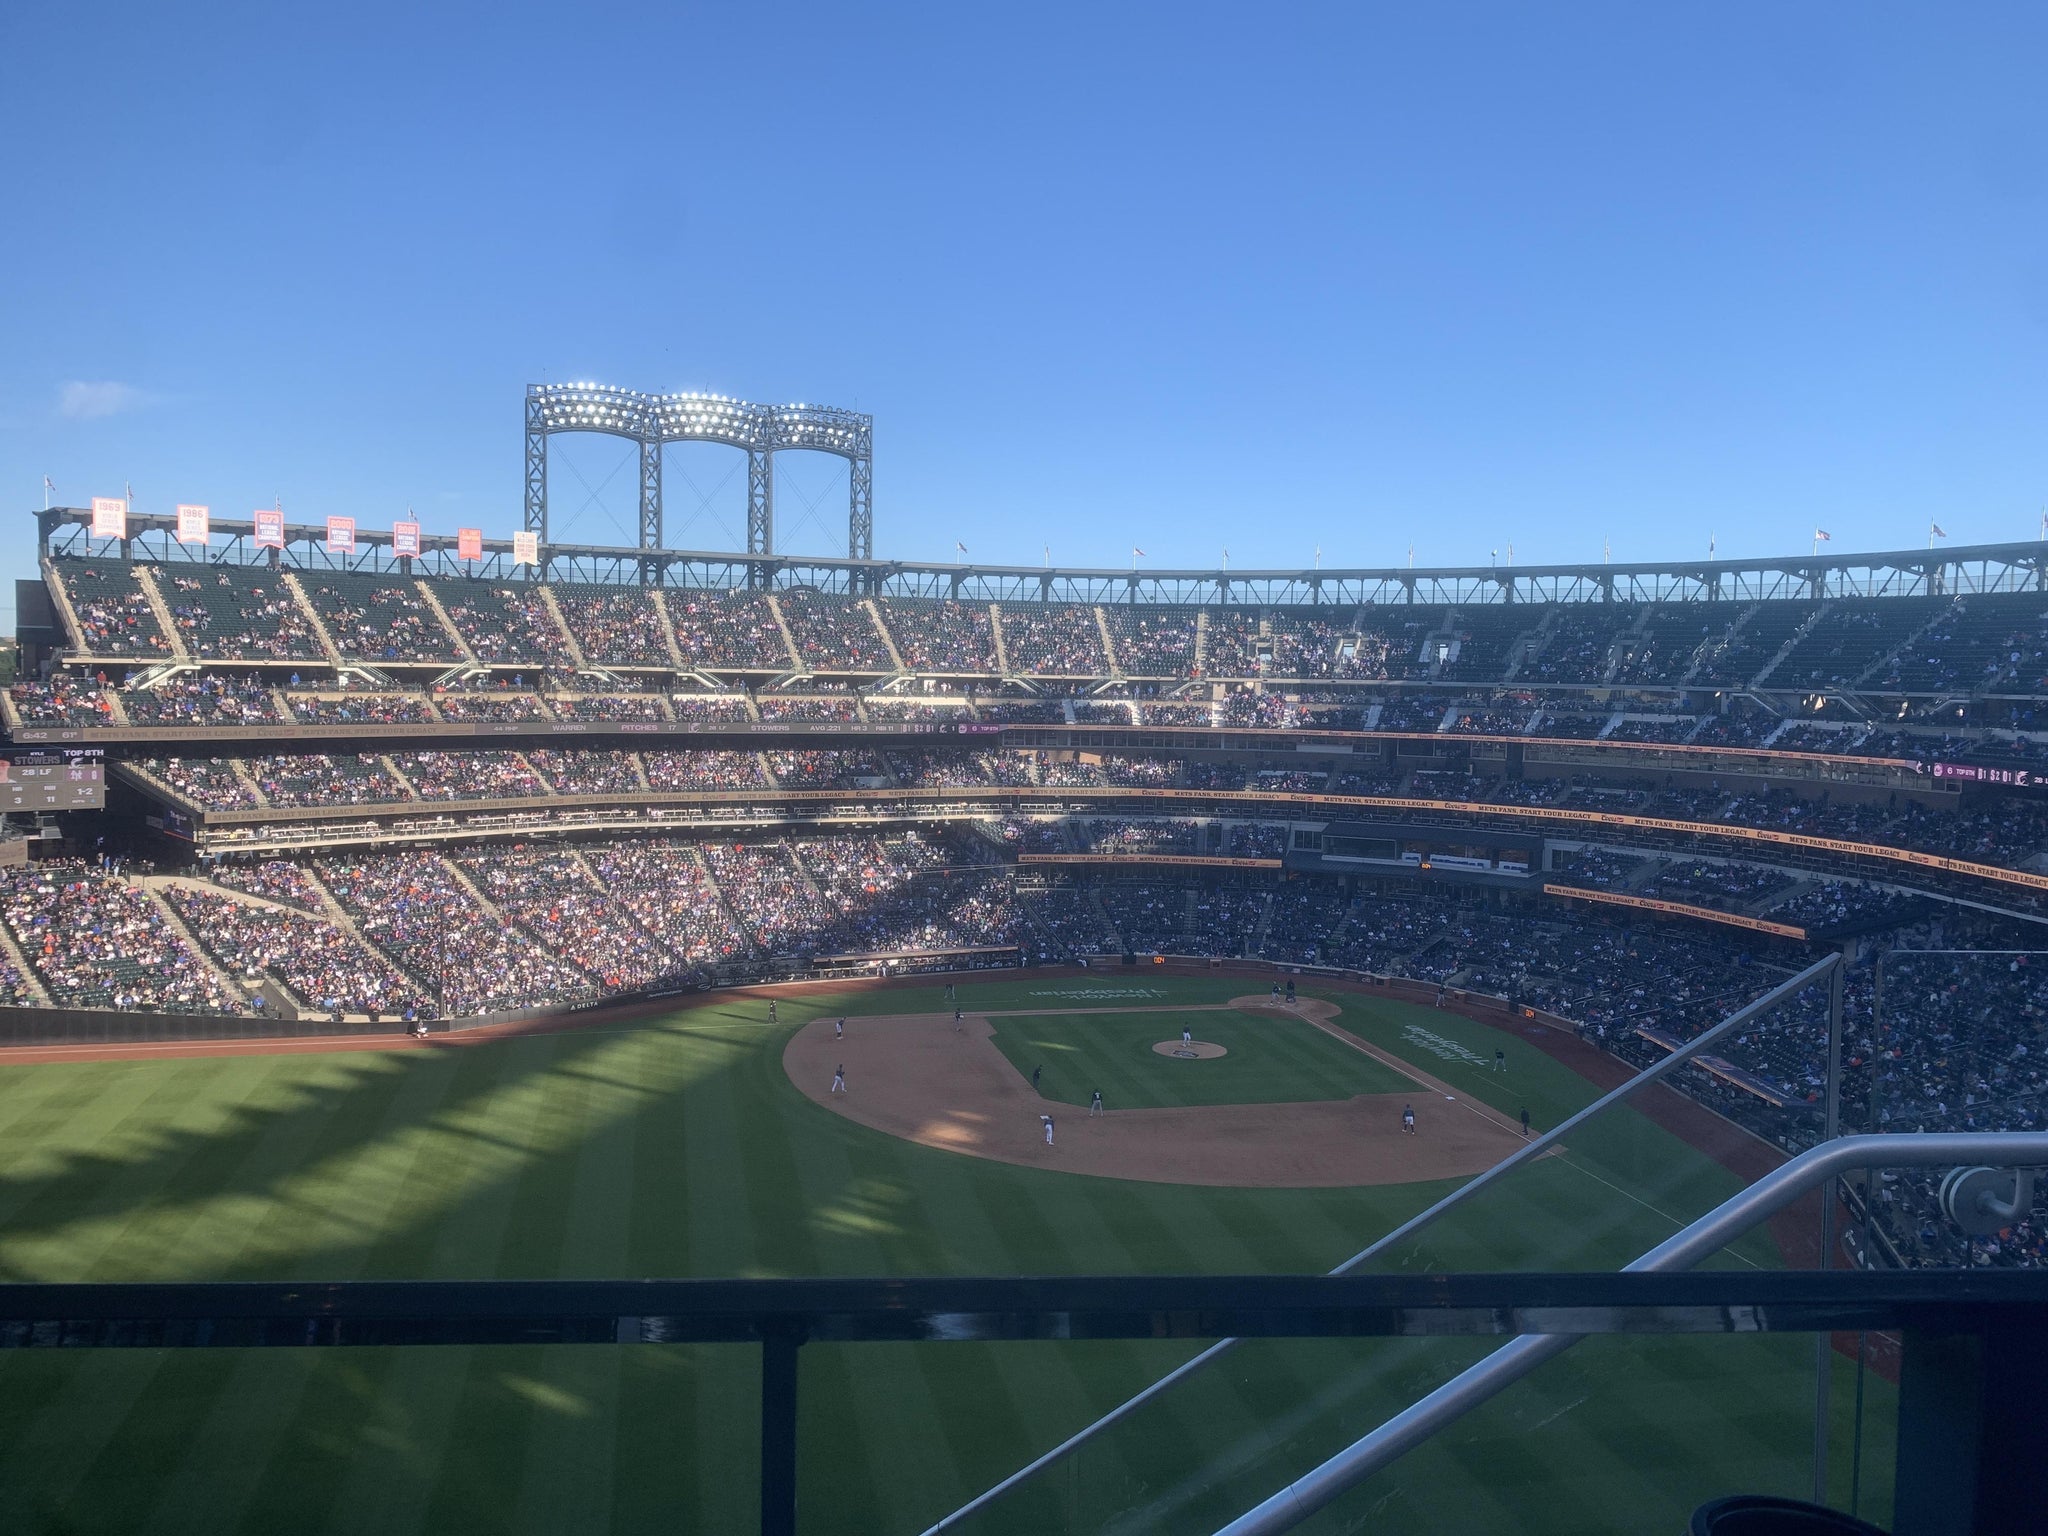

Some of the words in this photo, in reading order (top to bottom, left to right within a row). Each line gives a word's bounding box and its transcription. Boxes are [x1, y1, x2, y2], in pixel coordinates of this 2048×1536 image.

[100, 502, 120, 511] 1969
[184, 509, 203, 518] 1986
[15, 756, 60, 765] STOWERS
